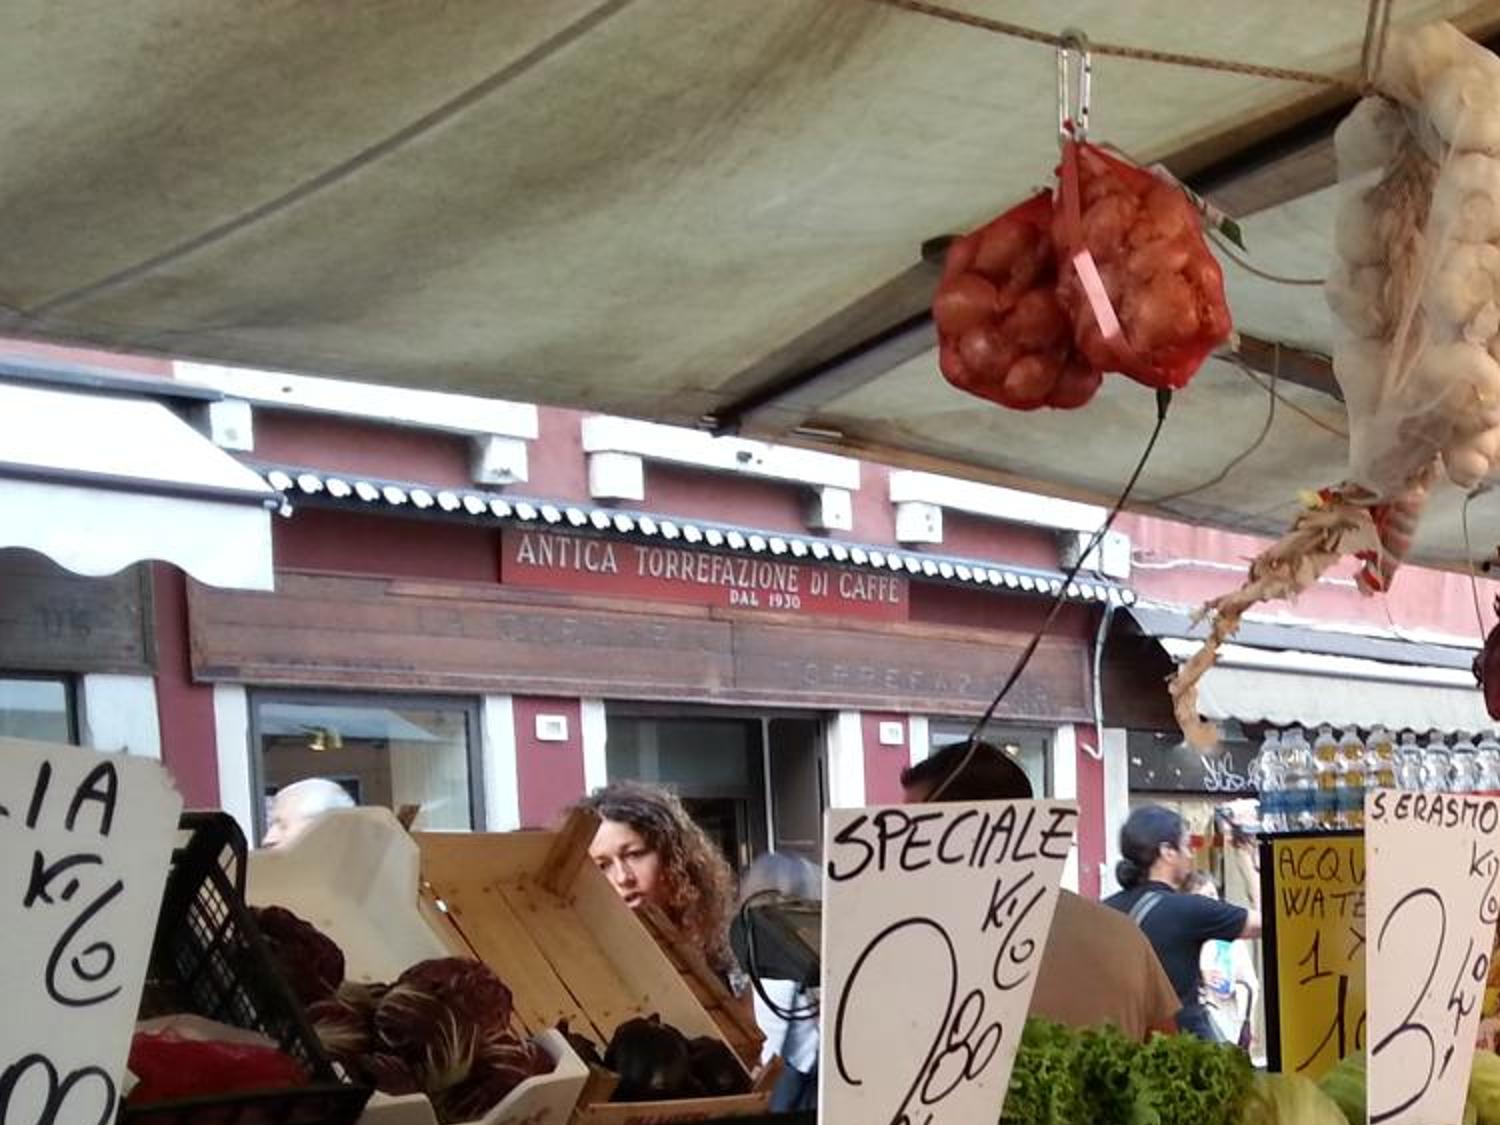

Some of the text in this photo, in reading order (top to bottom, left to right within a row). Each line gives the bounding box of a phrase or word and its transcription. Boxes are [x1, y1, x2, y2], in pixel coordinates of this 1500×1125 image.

[515, 533, 618, 574] ANTICA
[634, 545, 799, 593] TORREFAZIONE
[729, 588, 801, 610] DAL 1930
[0, 760, 118, 836] IA
[1394, 793, 1499, 834] ERASMO
[828, 803, 1079, 883] SPECIALE
